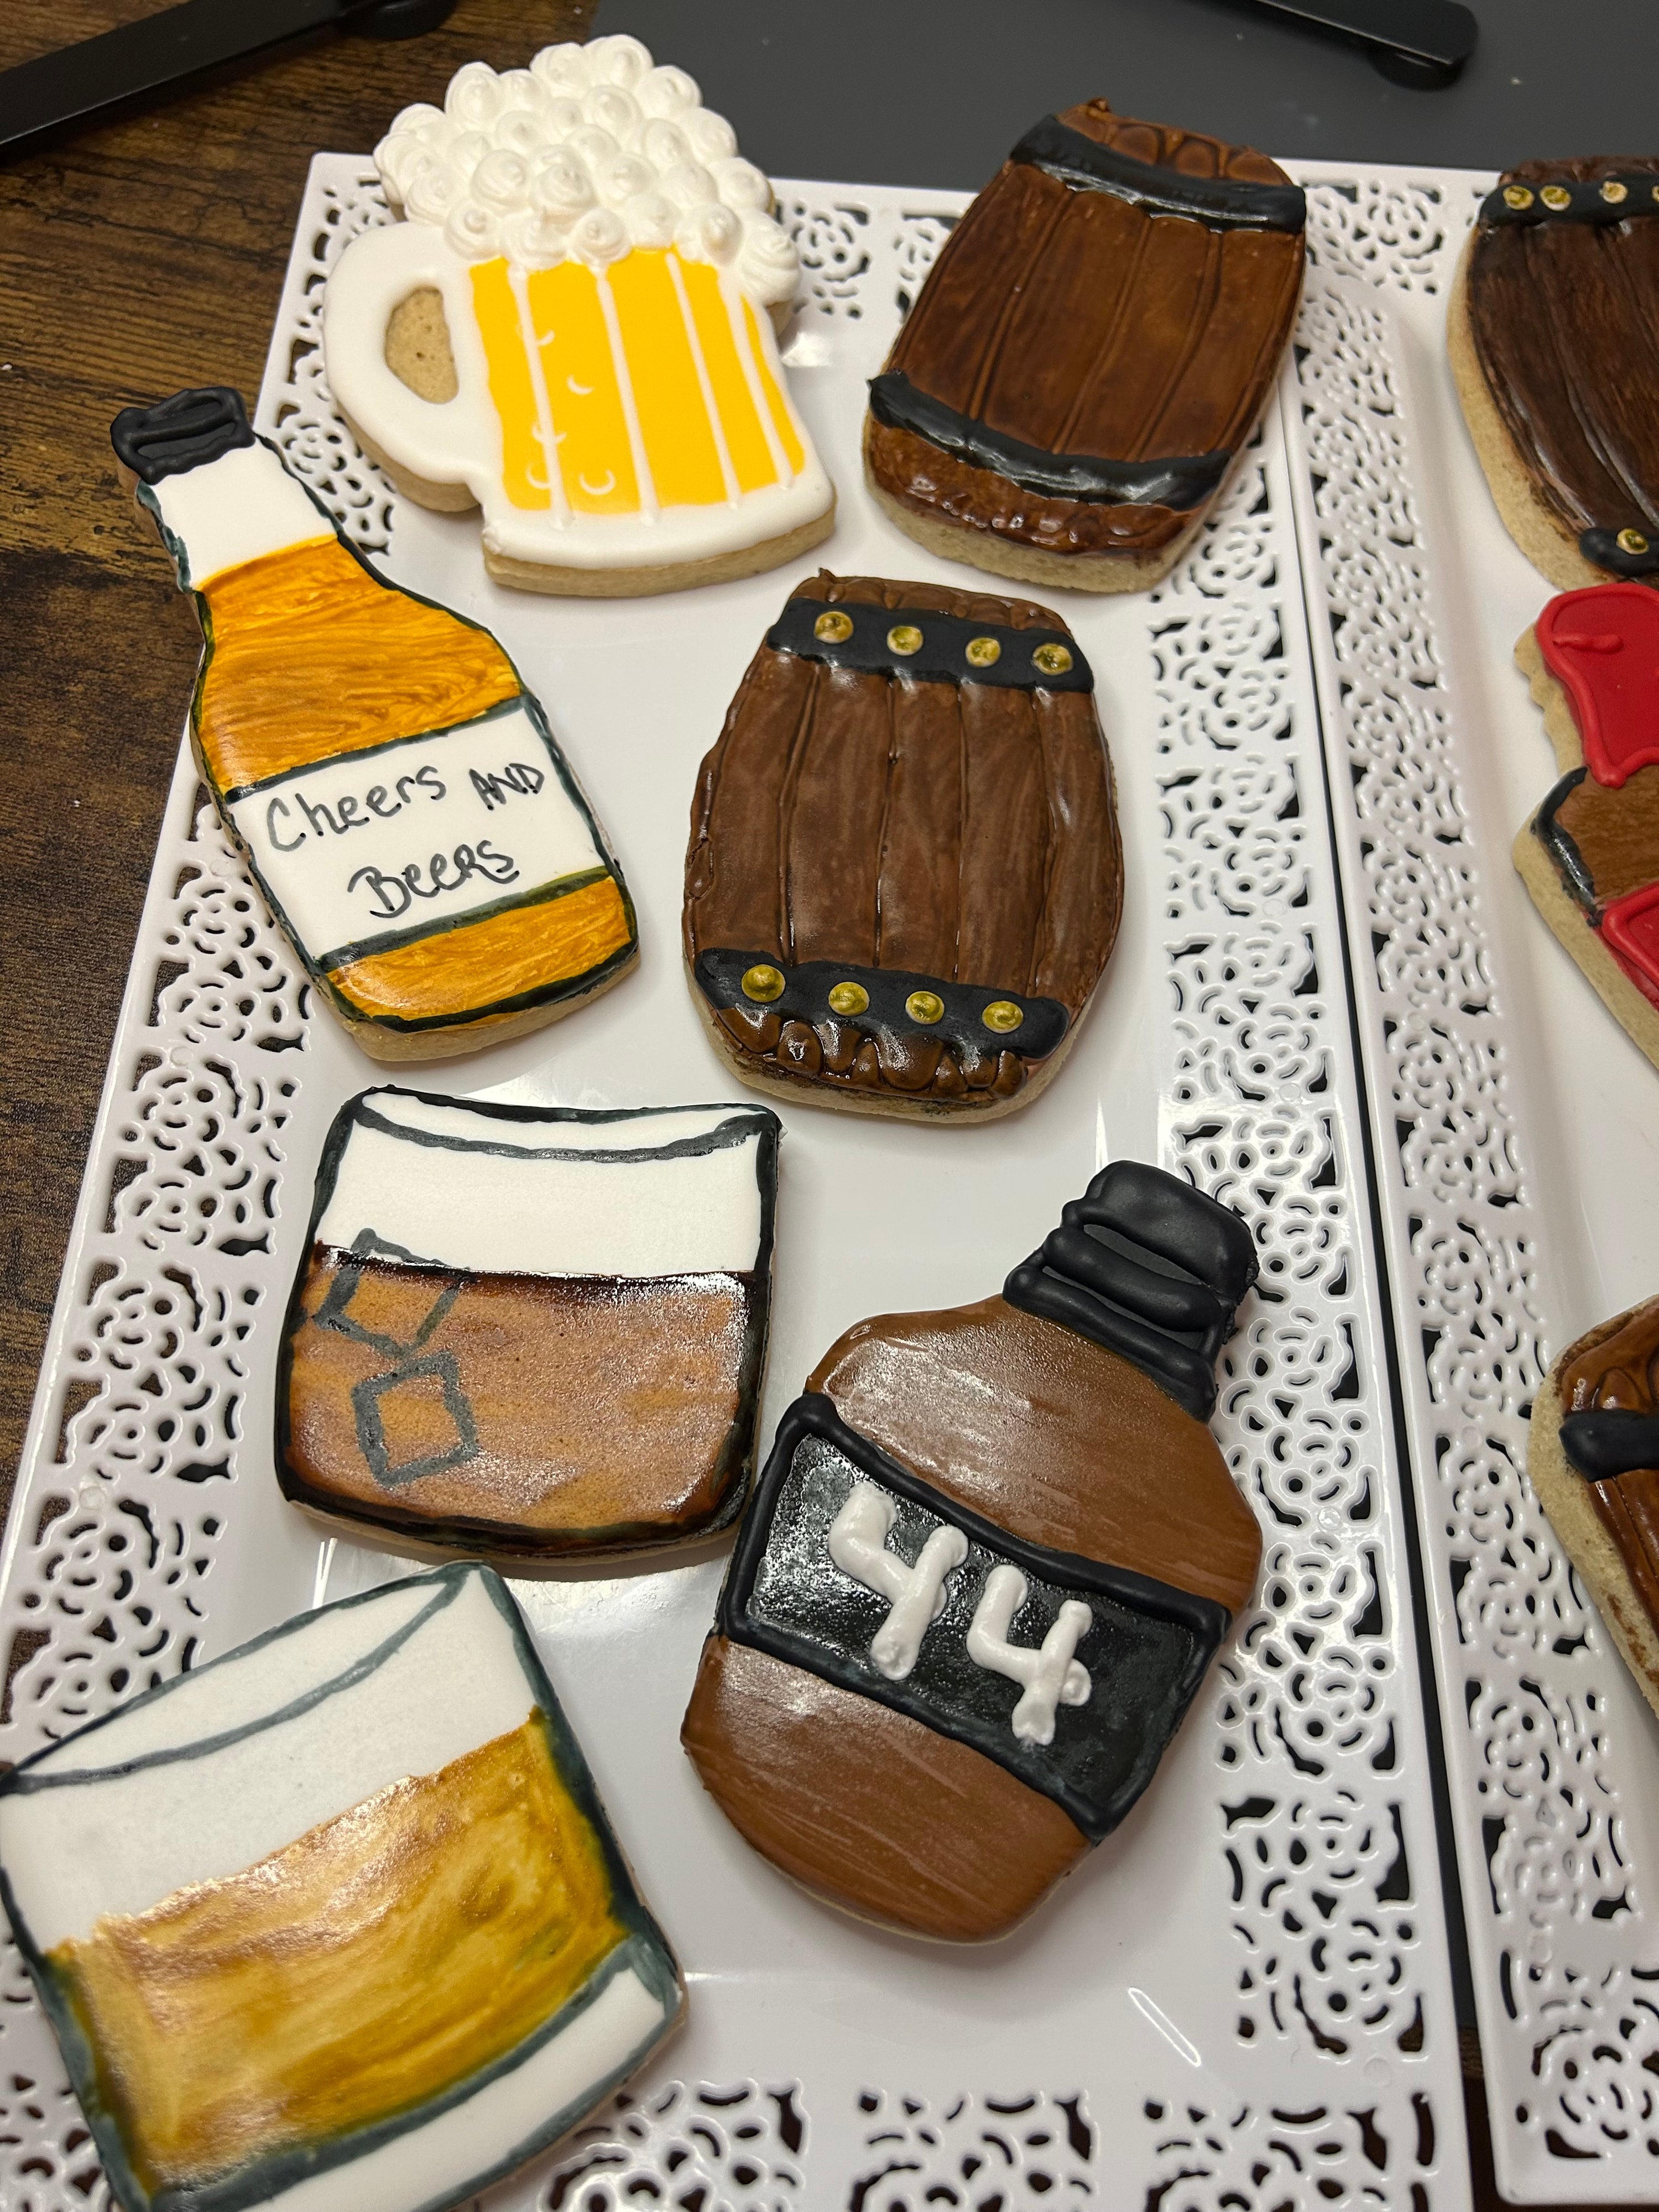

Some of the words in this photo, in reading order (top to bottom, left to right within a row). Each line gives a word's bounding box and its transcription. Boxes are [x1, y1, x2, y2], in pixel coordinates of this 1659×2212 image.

[267, 765, 447, 852] Cheers
[468, 763, 545, 811] AND
[829, 1481, 1093, 1746] 44
